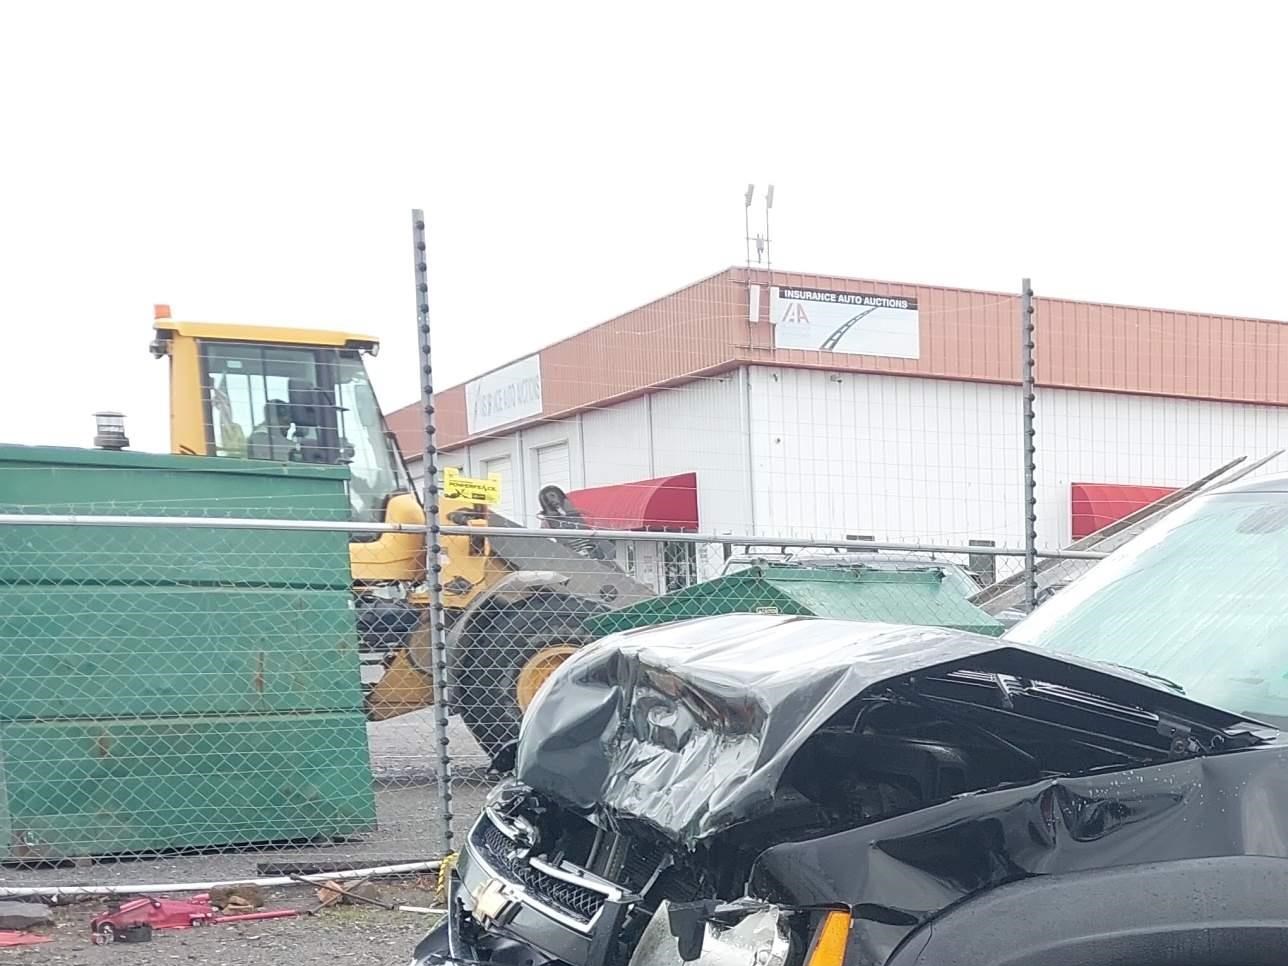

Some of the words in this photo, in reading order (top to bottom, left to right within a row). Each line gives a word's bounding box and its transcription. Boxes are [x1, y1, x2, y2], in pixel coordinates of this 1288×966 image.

[784, 290, 836, 301] INSURANCE
[838, 294, 863, 304] AUTO
[863, 297, 908, 308] AUCTIONS
